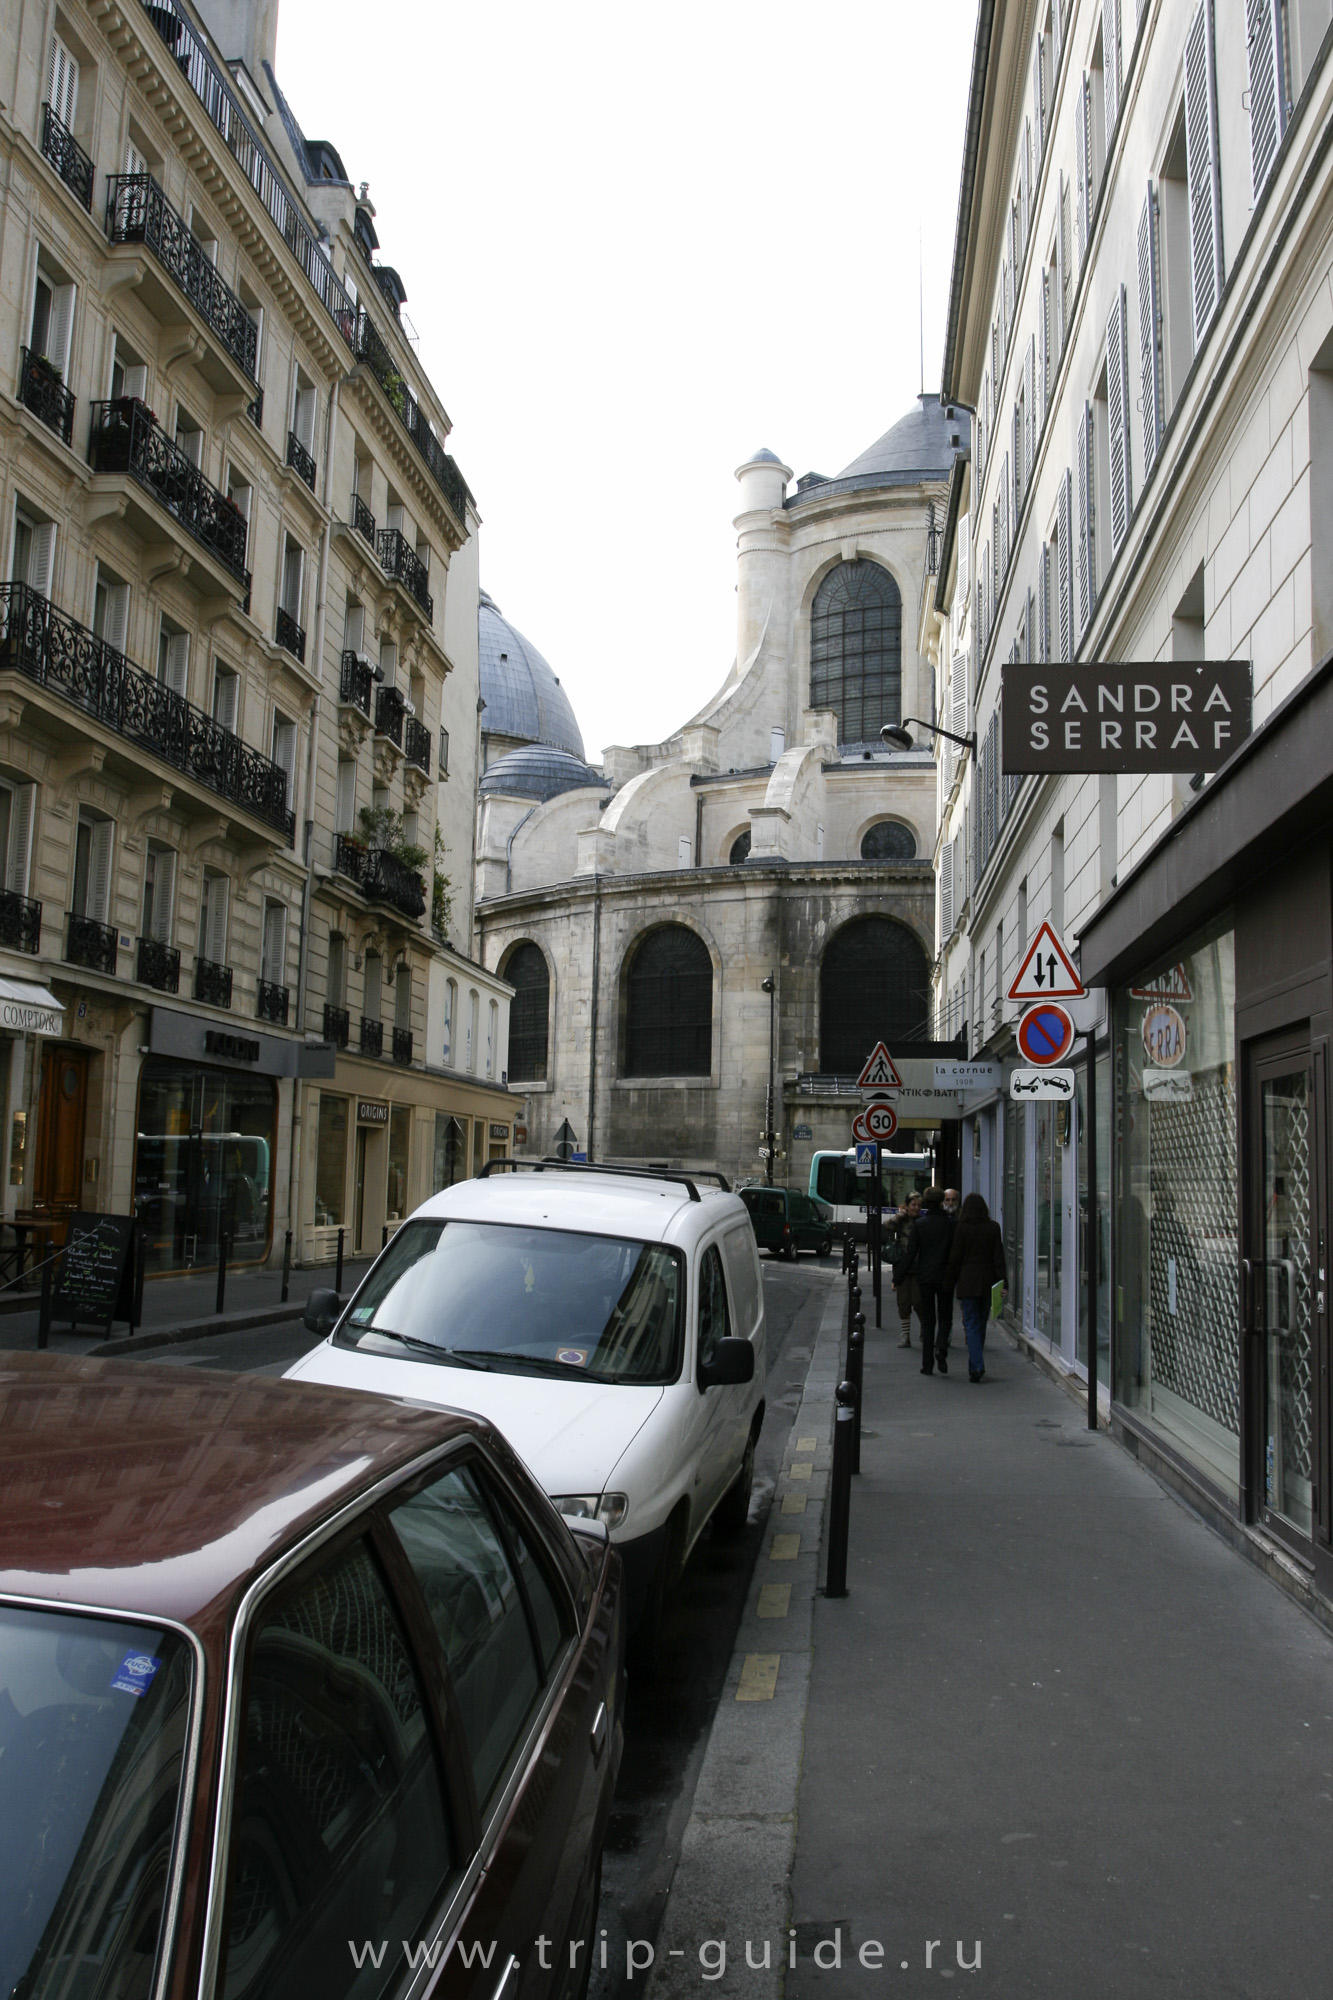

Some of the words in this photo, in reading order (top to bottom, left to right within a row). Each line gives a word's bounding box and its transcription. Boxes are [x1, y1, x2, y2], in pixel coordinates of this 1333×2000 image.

[1029, 683, 1232, 714] SANDRA
[1029, 720, 1231, 750] SERRAF
[3, 1006, 56, 1032] COMPTOIR
[935, 1066, 946, 1074] la
[899, 1089, 922, 1097] NTIK
[934, 1089, 958, 1097] BATI
[360, 1104, 387, 1120] ORIGINS
[872, 1115, 891, 1129] 30
[126, 1659, 154, 1672] FUCHS
